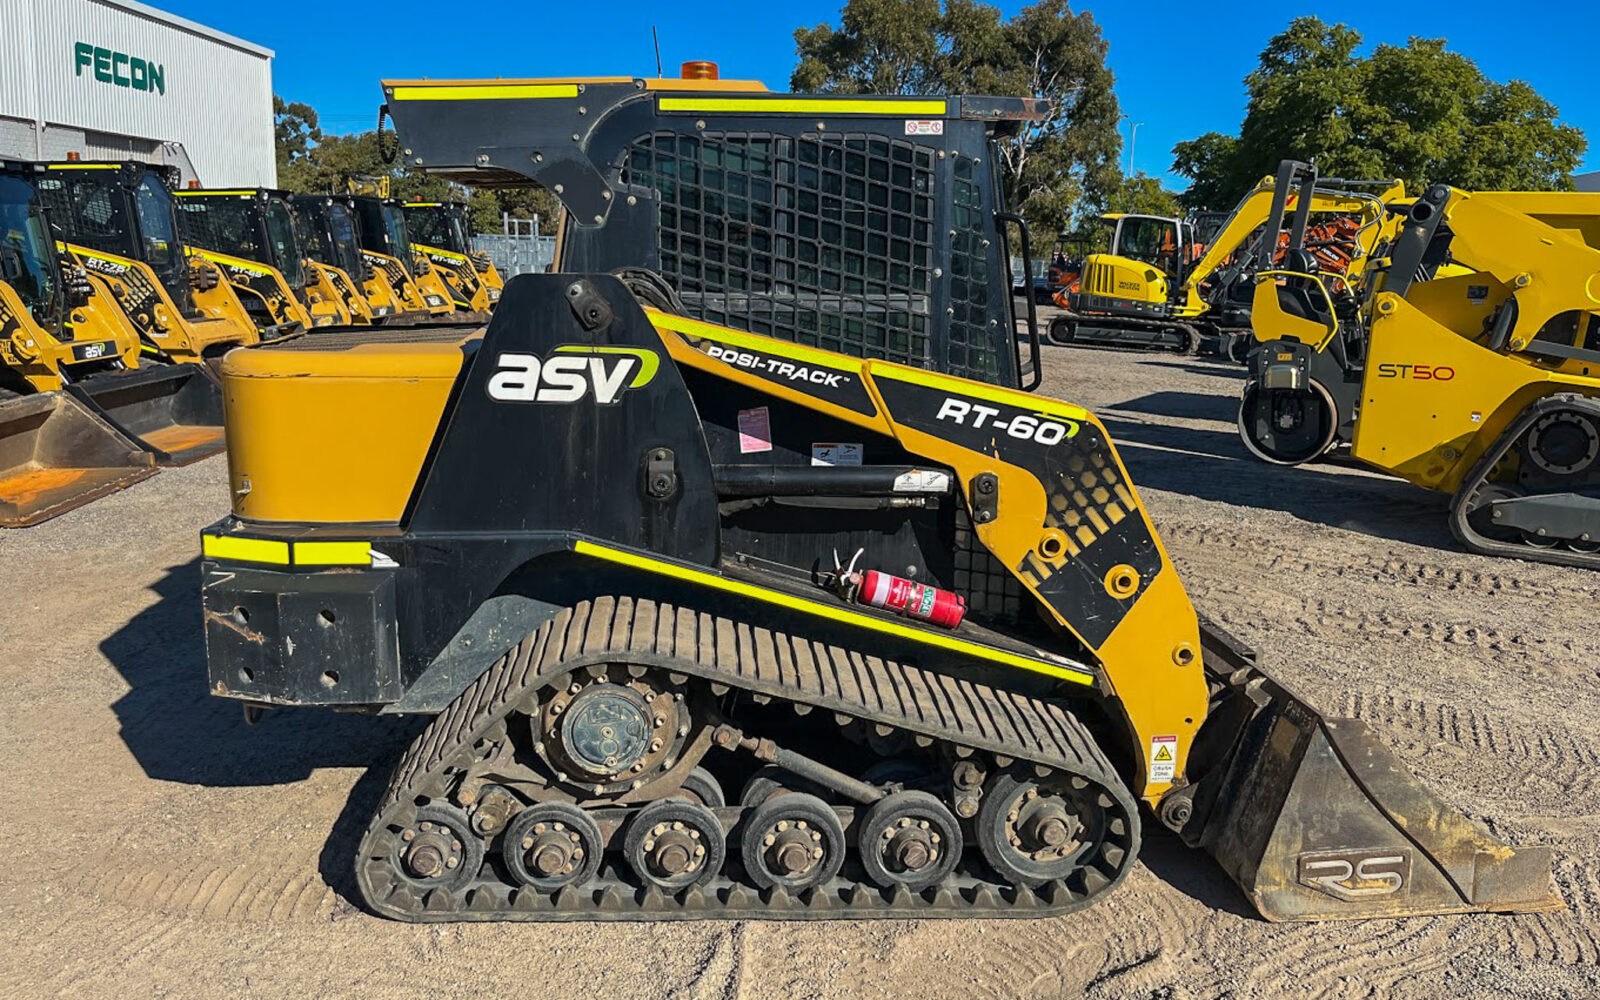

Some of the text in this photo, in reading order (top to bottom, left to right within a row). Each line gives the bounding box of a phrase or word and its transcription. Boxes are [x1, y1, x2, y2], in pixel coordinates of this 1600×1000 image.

[75, 41, 165, 96] FECON
[1378, 363, 1455, 381] ST50
[936, 398, 1067, 446] RT-60
